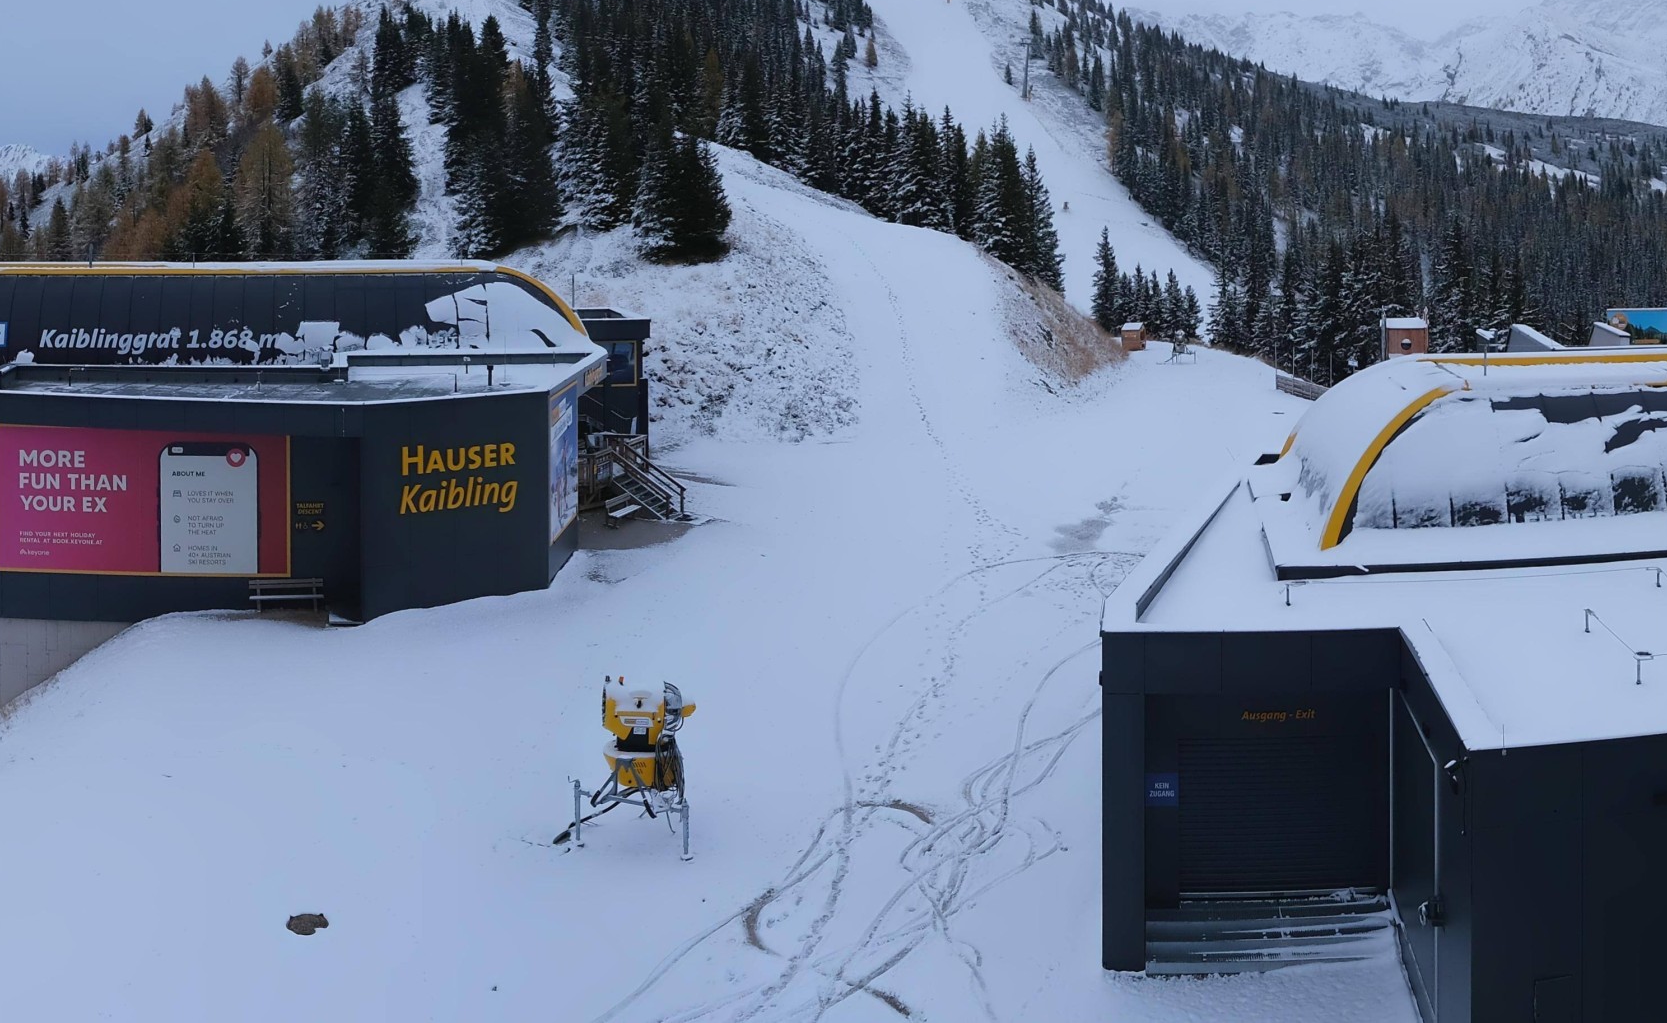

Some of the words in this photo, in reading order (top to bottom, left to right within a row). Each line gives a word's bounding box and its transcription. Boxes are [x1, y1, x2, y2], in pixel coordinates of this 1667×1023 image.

[39, 328, 181, 354] Kaiblinggrat
[186, 329, 254, 349] 1.868
[19, 449, 85, 468] MORE
[402, 442, 516, 476] HAUSER
[19, 472, 60, 490] FUN
[67, 473, 127, 491] THAN
[20, 495, 76, 512] YOUR
[82, 496, 107, 513] EX
[400, 476, 518, 515] Kaibling
[1241, 710, 1287, 722] Ausgang
[1295, 709, 1316, 719] Exit
